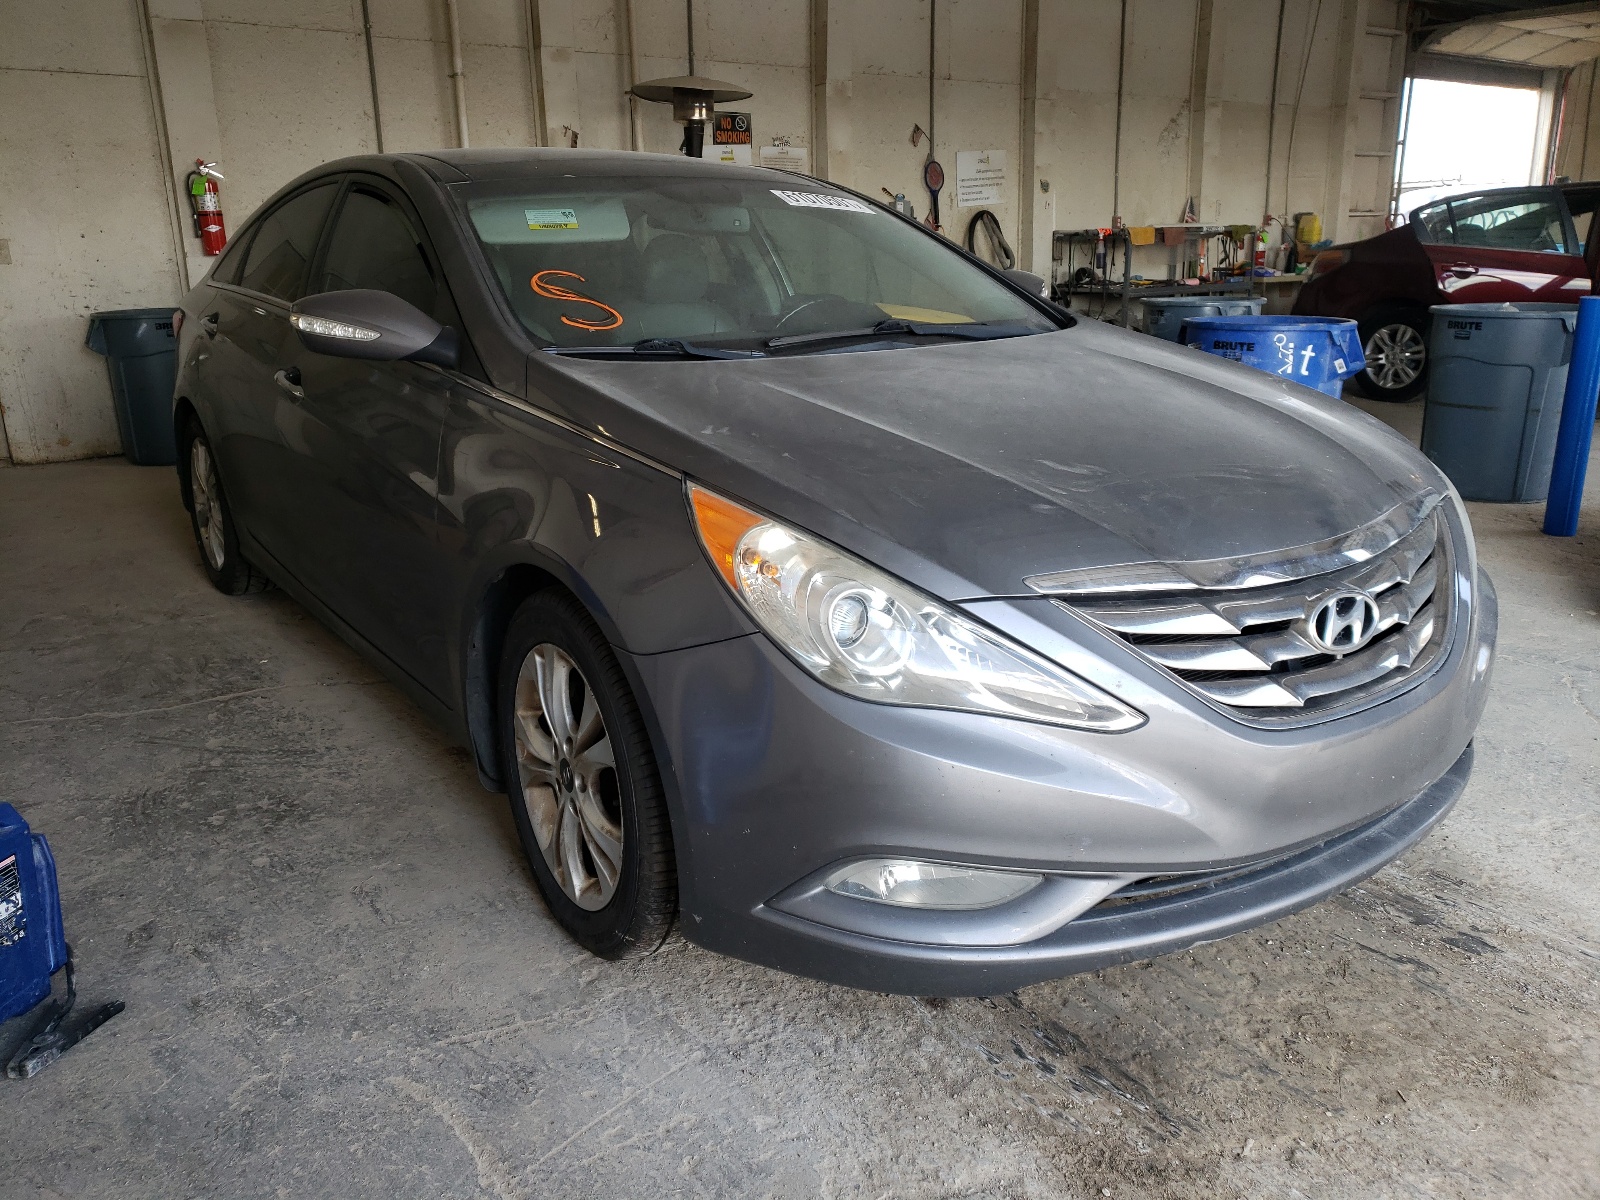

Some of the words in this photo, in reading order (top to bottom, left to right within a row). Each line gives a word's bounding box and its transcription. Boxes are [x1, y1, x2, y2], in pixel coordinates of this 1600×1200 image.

[721, 117, 732, 130] NO
[716, 130, 750, 143] SMOKING
[1447, 320, 1483, 331] BRUTE
[1213, 340, 1255, 351] BRUTE
